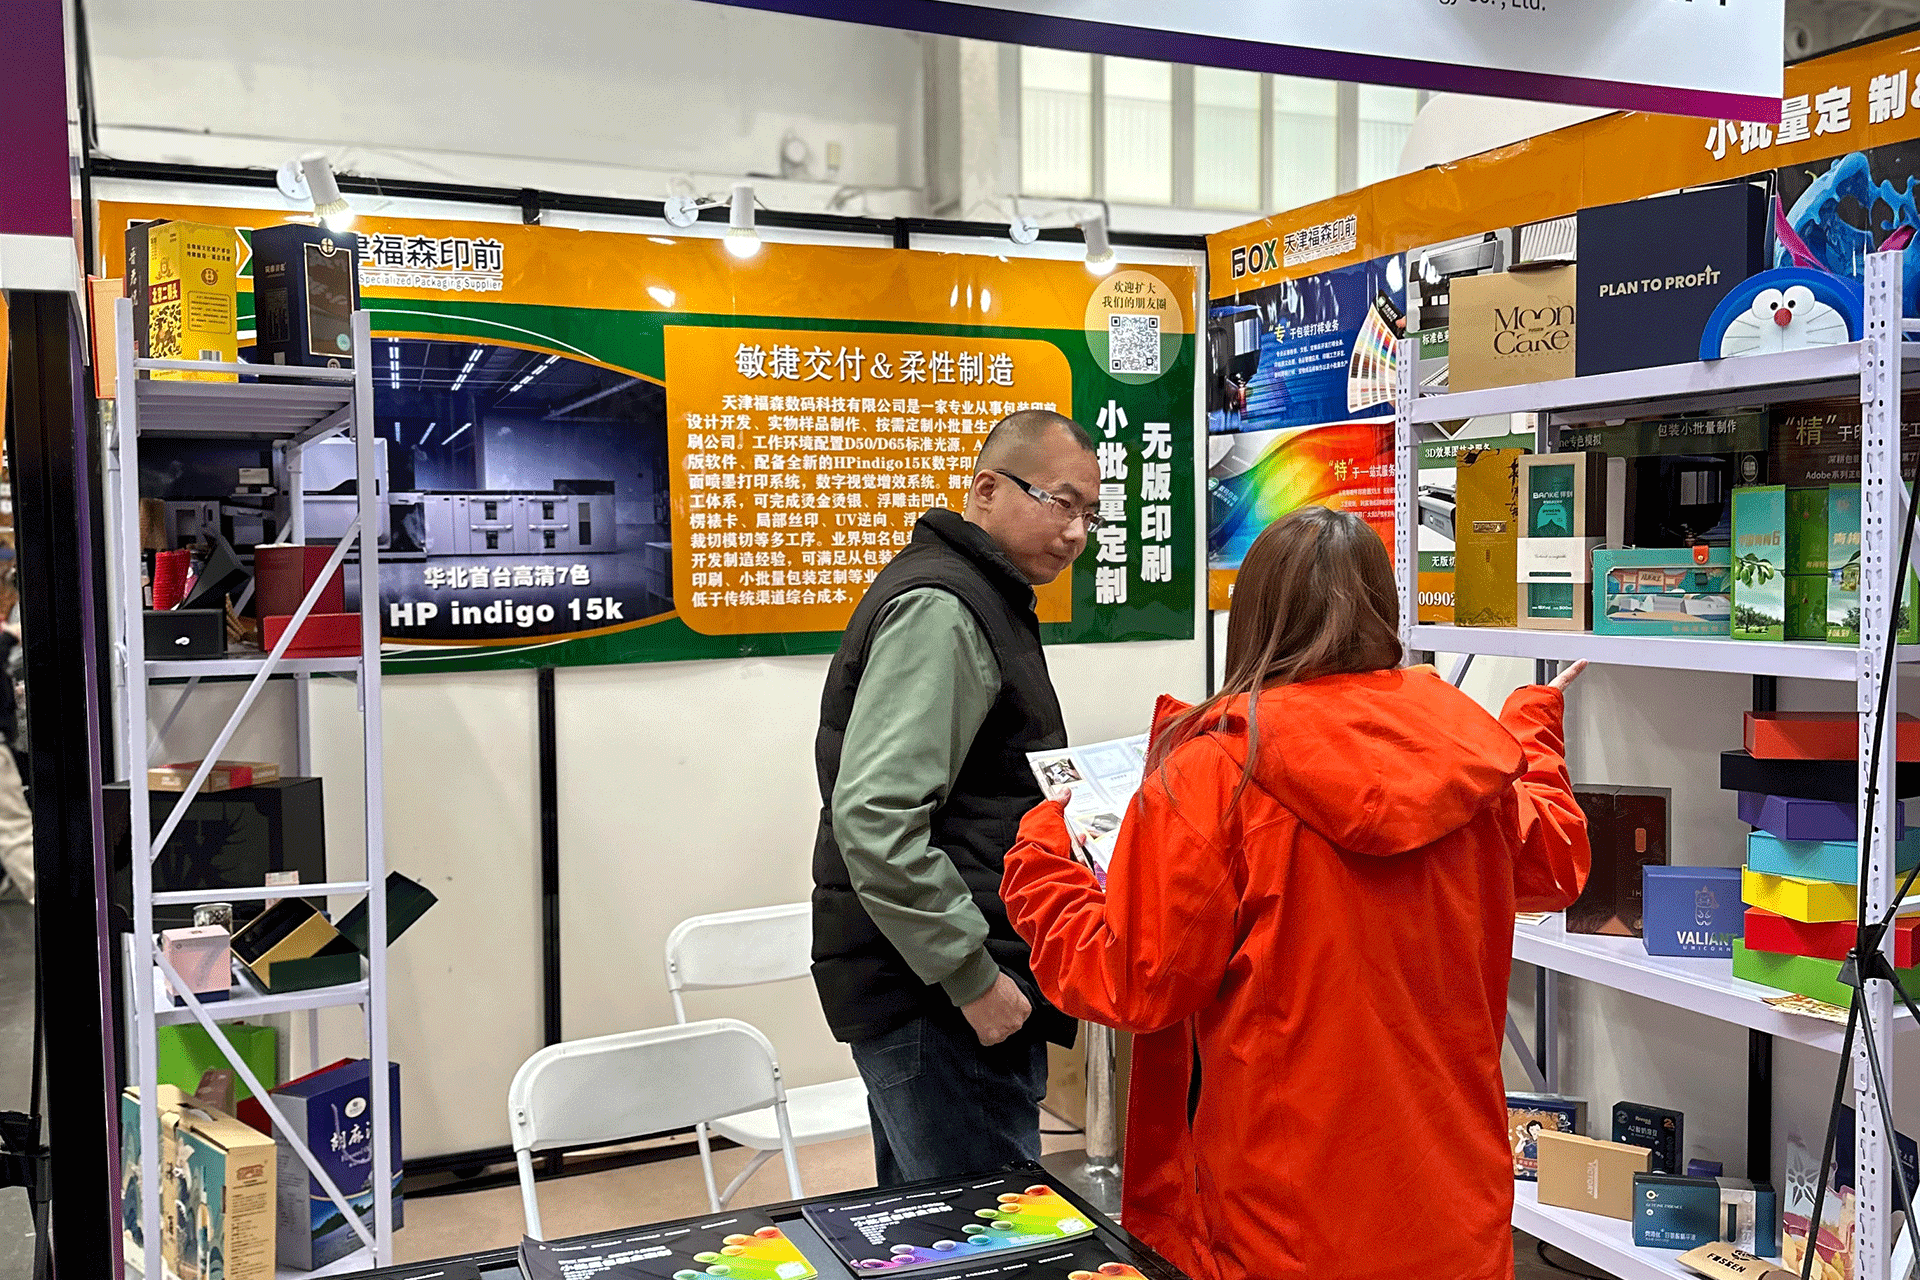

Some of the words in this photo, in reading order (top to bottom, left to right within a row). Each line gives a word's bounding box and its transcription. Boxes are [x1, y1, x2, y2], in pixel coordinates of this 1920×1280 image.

[1284, 216, 1356, 254] 天津福森印前
[415, 276, 461, 290] Packaging
[464, 278, 502, 290] Supplier
[1114, 281, 1156, 294] 欢迎扩大
[1599, 280, 1639, 297] PLAN
[1641, 278, 1662, 293] TO
[1665, 265, 1721, 290] PROFIT
[1101, 296, 1167, 310] 我们的朋友圈
[1494, 305, 1575, 332] Moon
[1493, 330, 1570, 355] Cake
[1657, 419, 1737, 437] 包装小批量制作
[687, 453, 978, 472] 版软件、配备全新的HPindigo15K数字印
[1095, 399, 1129, 605] 小批量定制
[1140, 422, 1173, 583] 无版印刷
[689, 512, 925, 529] 楞裱卡、局部丝印、UV逆向、浮
[691, 549, 901, 569] 开发制造经验，可满足从包装
[423, 564, 591, 589] 华北首台高清7色
[691, 588, 868, 608] 低于传统渠道综合成本，
[389, 602, 439, 627] HP
[450, 599, 555, 628] indigo
[567, 597, 624, 621] 15k
